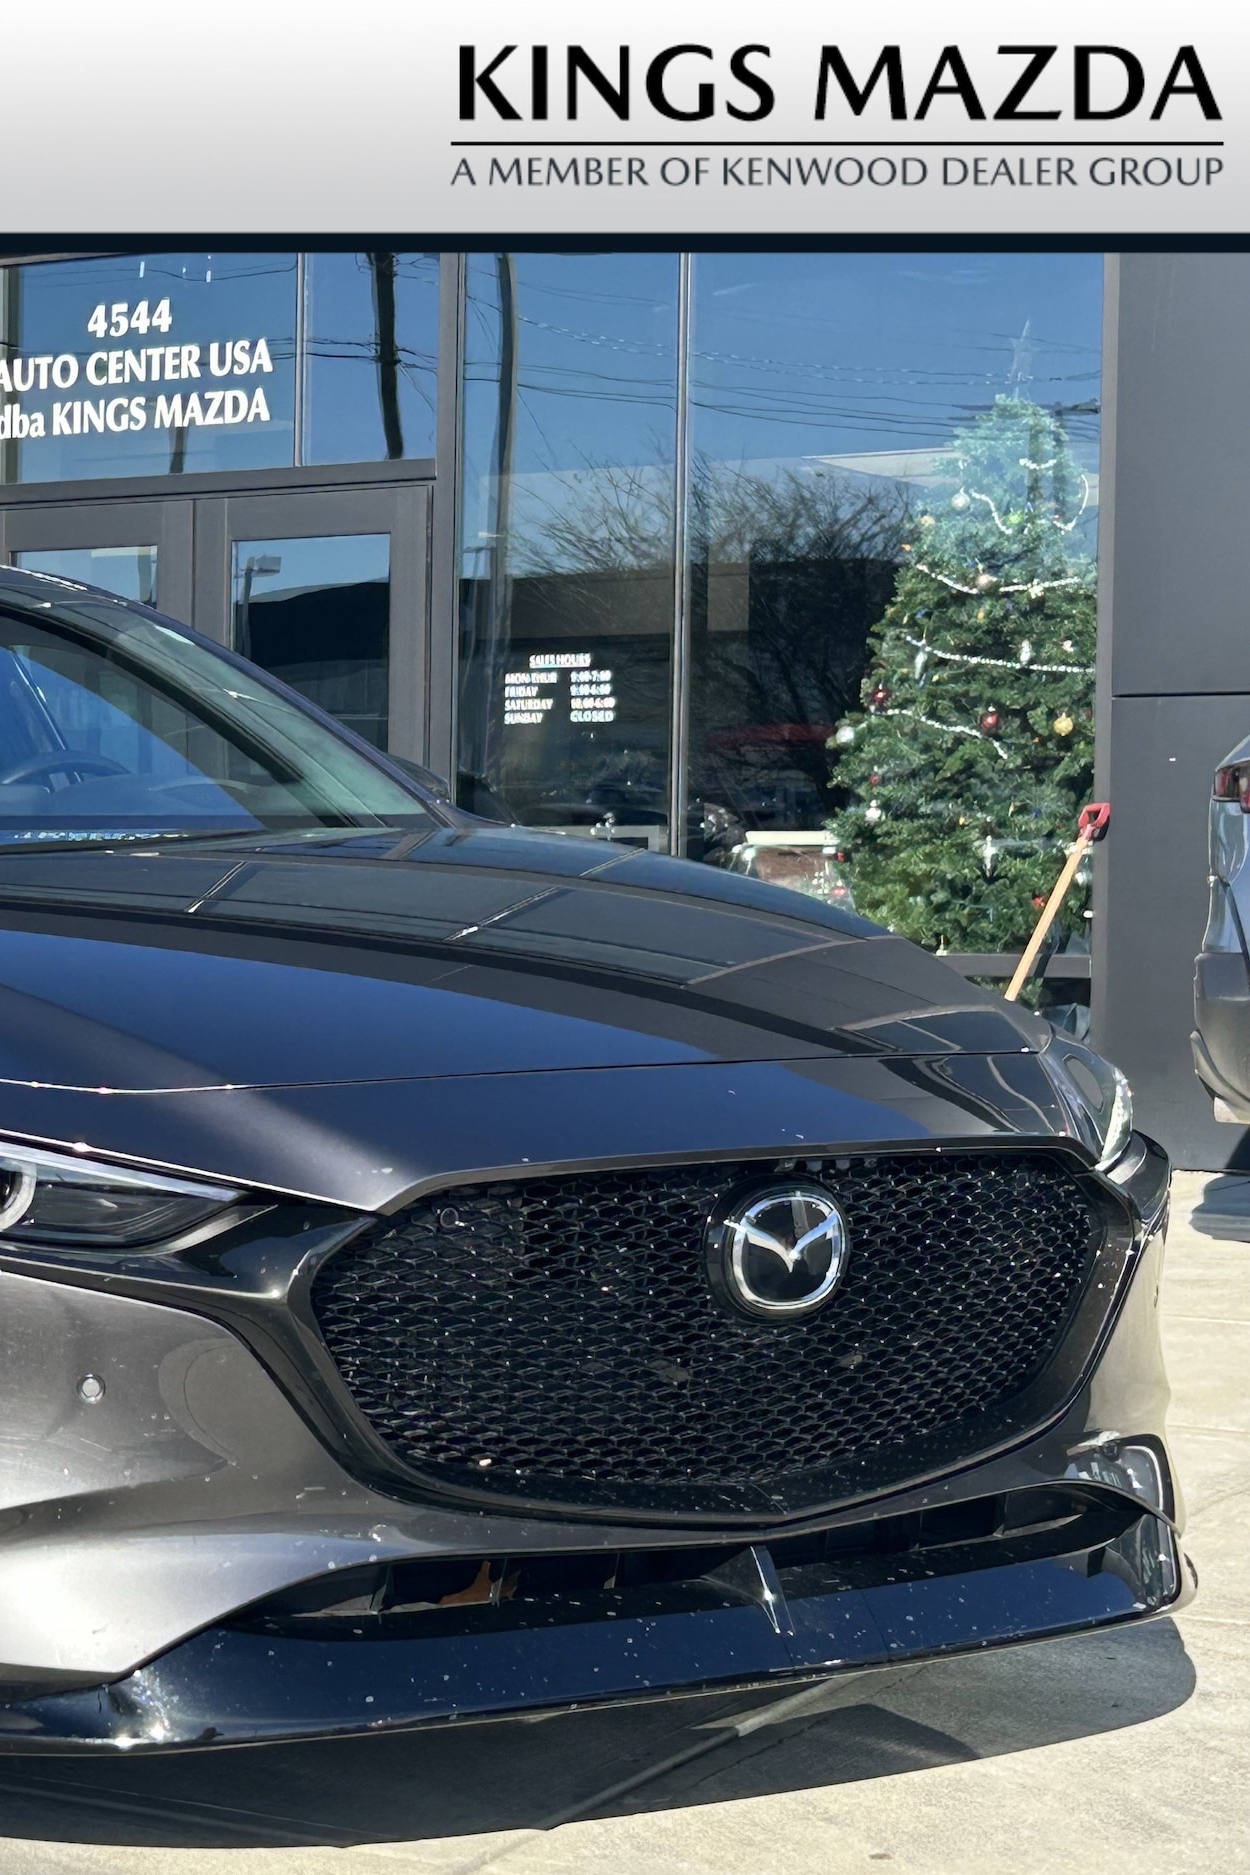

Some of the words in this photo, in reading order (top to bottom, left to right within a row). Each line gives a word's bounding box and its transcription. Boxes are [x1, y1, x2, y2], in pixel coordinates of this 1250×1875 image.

[88, 297, 172, 337] 4544
[87, 345, 201, 385] CENTER
[210, 337, 272, 376] USA
[53, 397, 146, 435] KINGS
[155, 388, 269, 428] MAZDA
[556, 653, 591, 666] HOURS
[505, 685, 539, 698] FRIDAY
[504, 698, 554, 711] SATURDAY
[504, 712, 543, 725] SUNDAY
[570, 710, 615, 723] CLOSED
